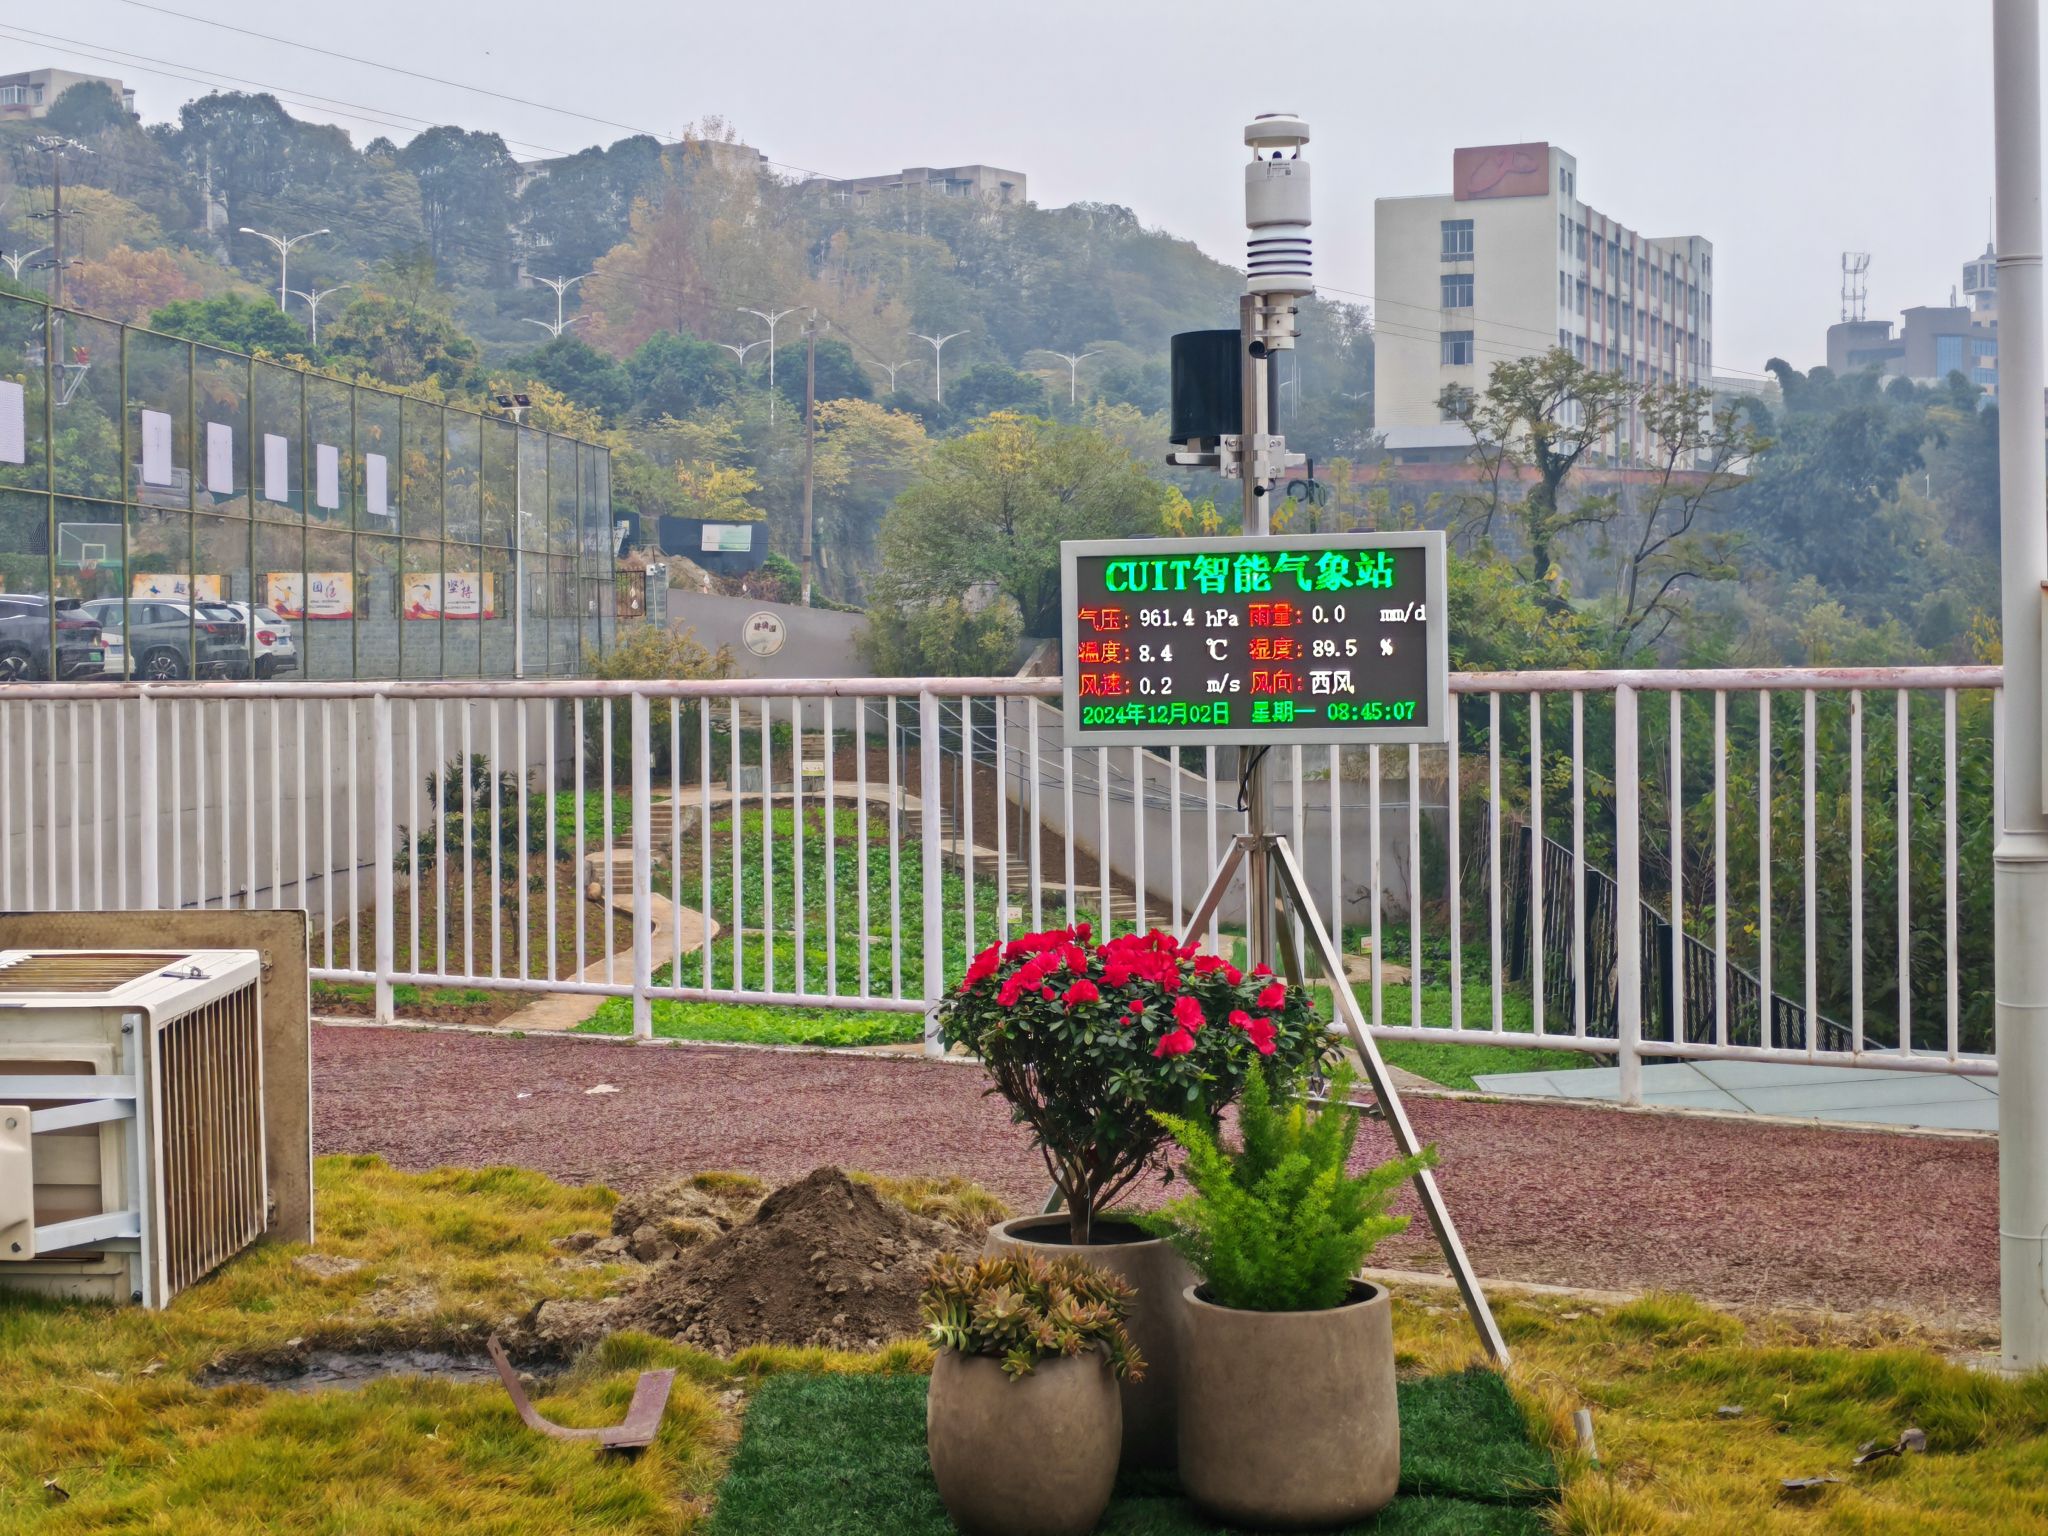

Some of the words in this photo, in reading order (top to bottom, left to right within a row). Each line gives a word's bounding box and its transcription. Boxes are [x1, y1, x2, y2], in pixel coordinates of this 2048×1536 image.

[1105, 551, 1394, 594] CUIT智能气象站
[1139, 606, 1195, 627] 961.4
[1205, 609, 1239, 628] hPa
[1312, 605, 1346, 623] 0.0
[1380, 602, 1426, 622] mm/d
[1139, 644, 1173, 662] 8.4
[1206, 638, 1228, 661] ℃
[1312, 639, 1357, 657] 89.5
[1380, 638, 1394, 656] %
[1139, 677, 1172, 695] 0.2
[1206, 673, 1241, 694] m/s
[1309, 670, 1355, 695] 西风
[1083, 702, 1229, 725] 2024年12月02日
[1252, 701, 1316, 722] 星期一
[1327, 702, 1416, 720] 08:45:07
